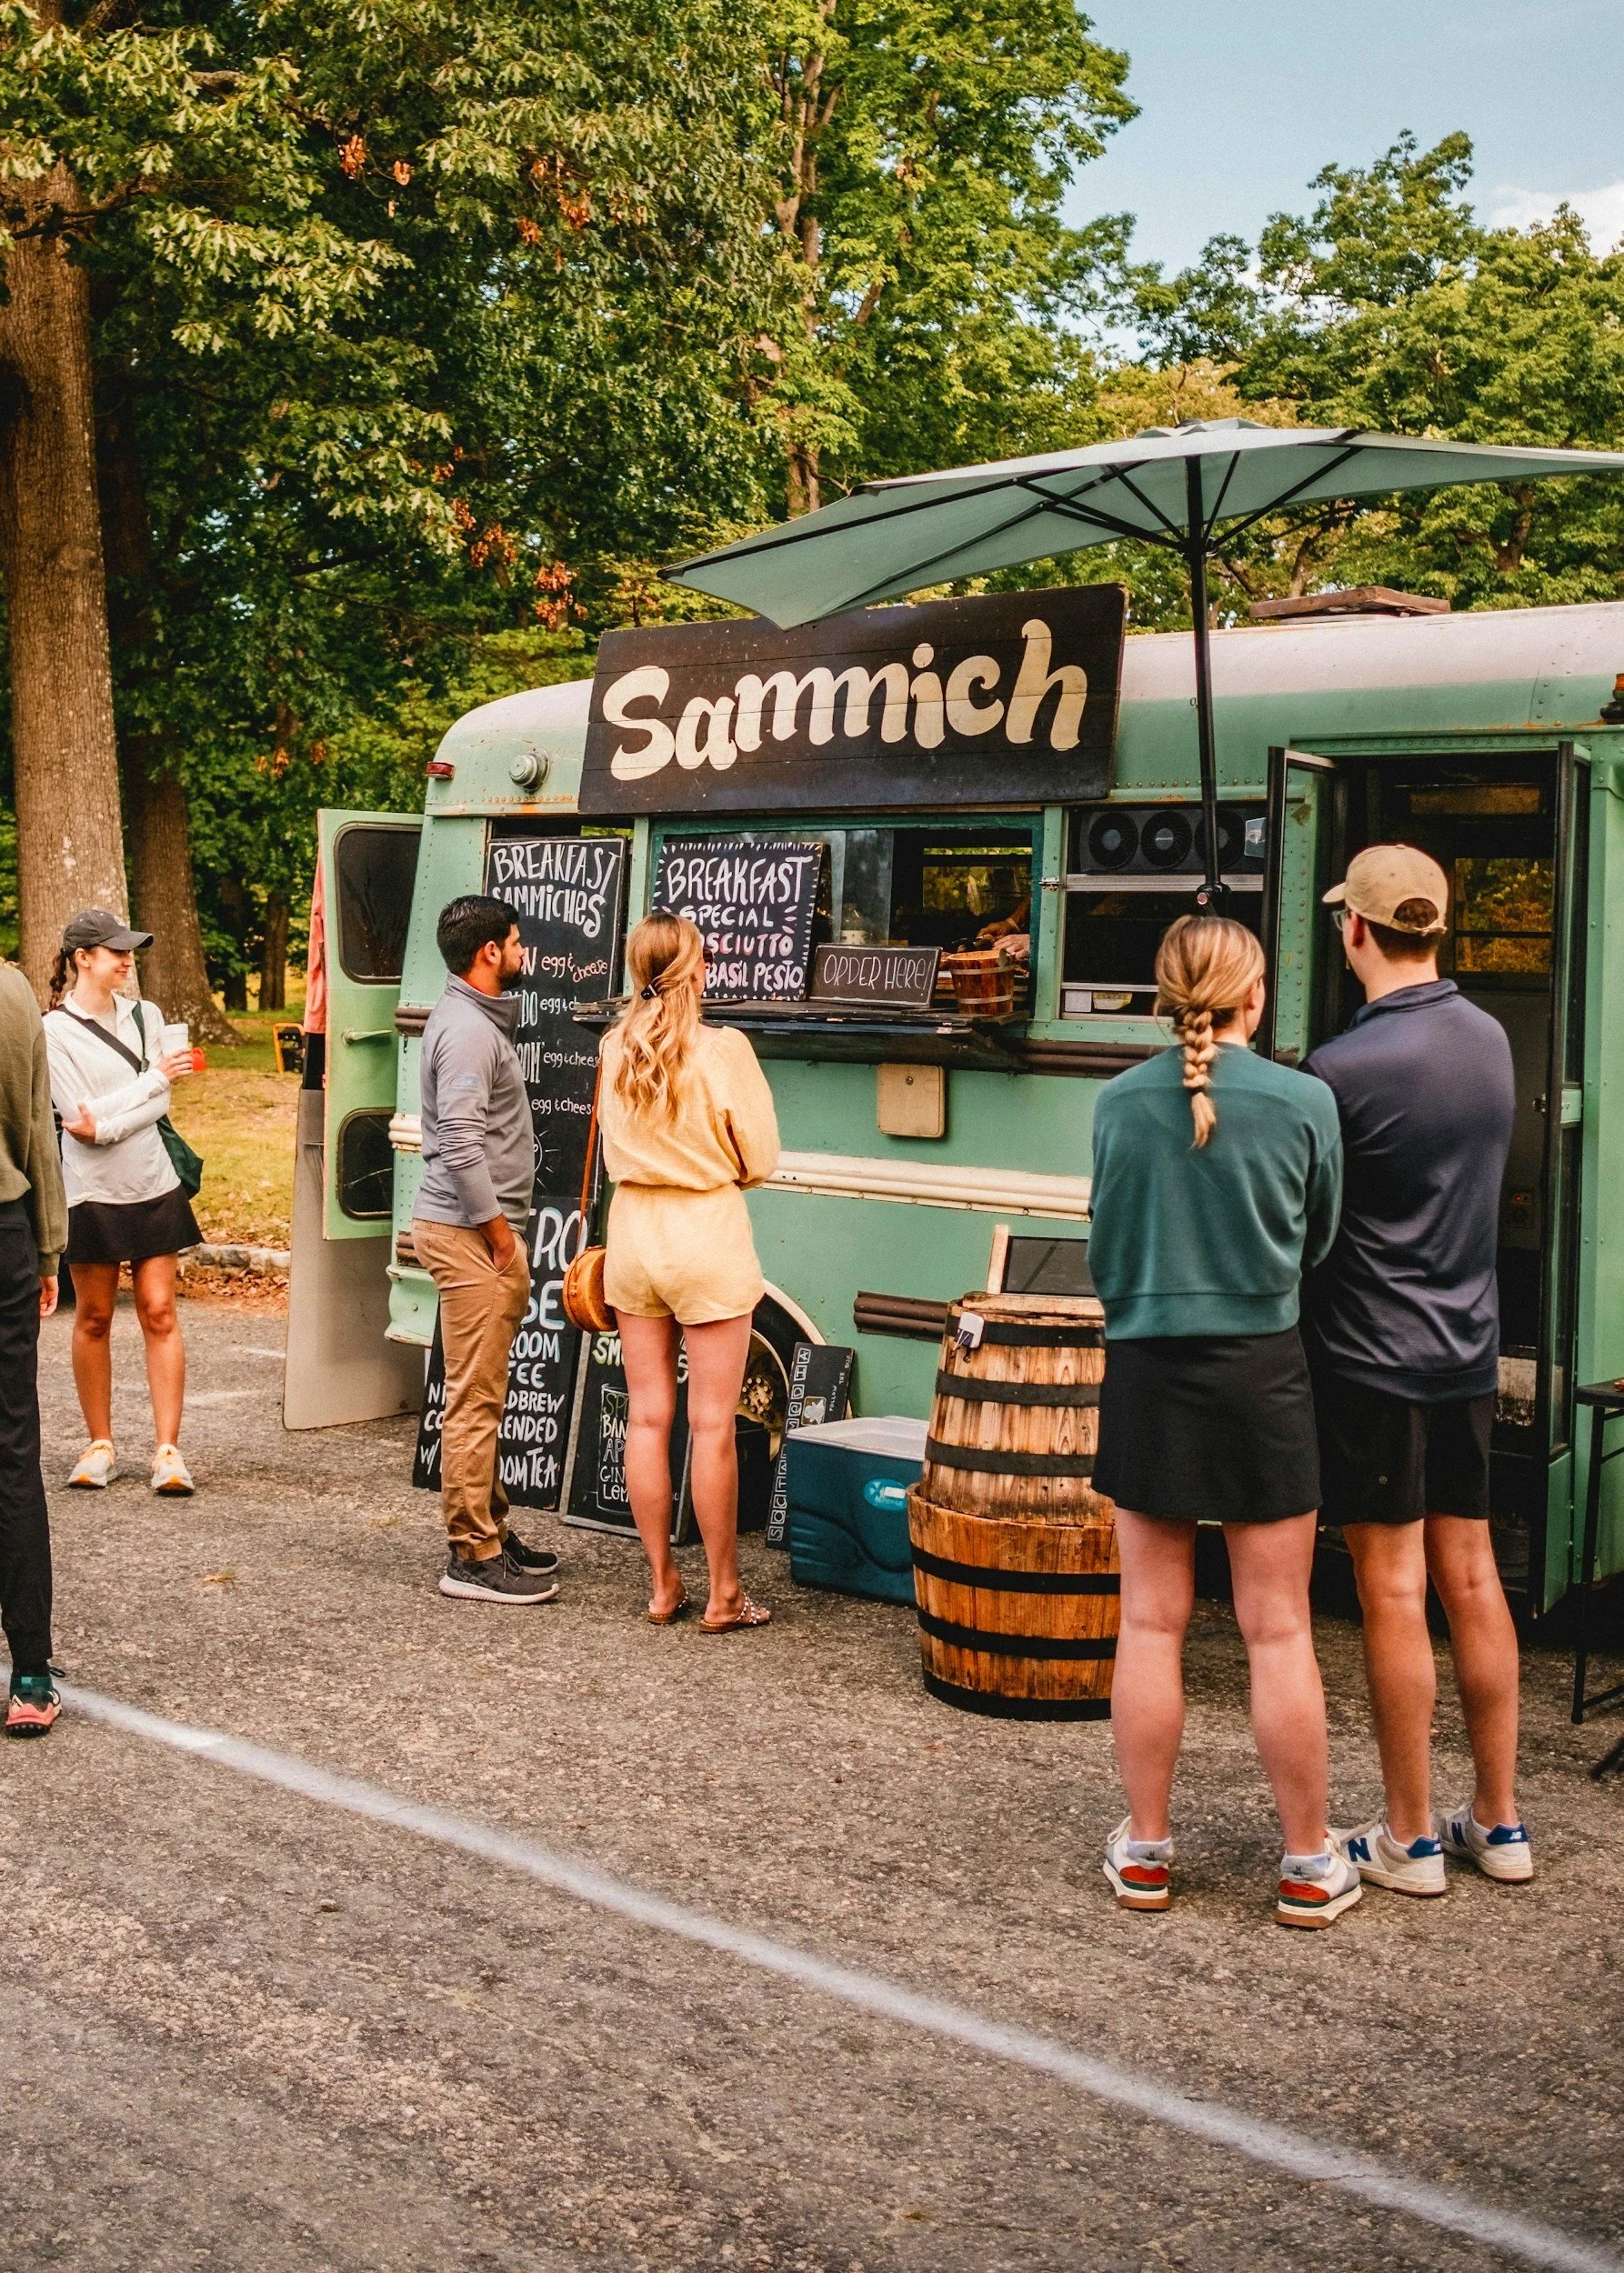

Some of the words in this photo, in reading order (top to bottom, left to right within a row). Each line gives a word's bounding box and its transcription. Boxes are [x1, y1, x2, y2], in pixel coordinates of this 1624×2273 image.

[602, 618, 1088, 781] Sammich
[494, 844, 621, 896] BREAKFAST
[667, 856, 814, 906] BREAKFAST
[679, 904, 774, 928] SPECIAL
[699, 931, 794, 958] SCIUTTO
[541, 956, 566, 978] egg
[753, 959, 804, 993] PESTO
[824, 954, 881, 990] ORDER
[539, 997, 561, 1015] egg
[543, 1051, 563, 1068] egg
[569, 1051, 599, 1068] chees
[531, 1098, 551, 1115] egg
[560, 1093, 594, 1116] chees
[497, 1415, 558, 1444] LENDED
[602, 1414, 629, 1440] BAN
[768, 1445, 787, 1541] SOCIA
[1347, 1837, 1372, 1862] N
